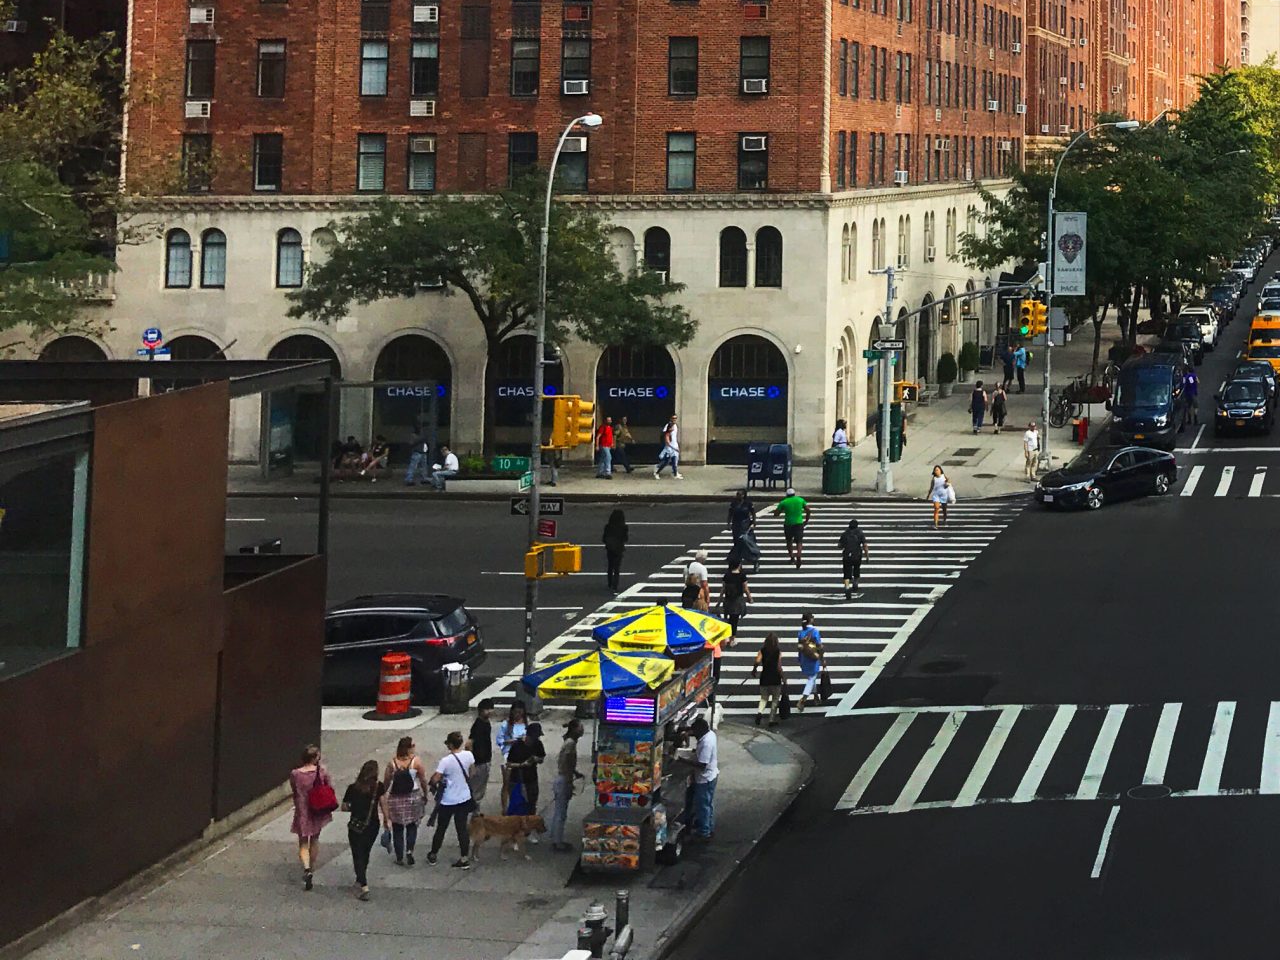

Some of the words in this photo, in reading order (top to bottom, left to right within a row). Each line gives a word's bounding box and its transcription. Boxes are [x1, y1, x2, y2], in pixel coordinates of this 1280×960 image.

[387, 386, 431, 397] CHASE
[498, 386, 535, 397] CHAS
[609, 387, 654, 398] CHASE
[720, 386, 765, 397] CHASE
[499, 459, 511, 469] 10
